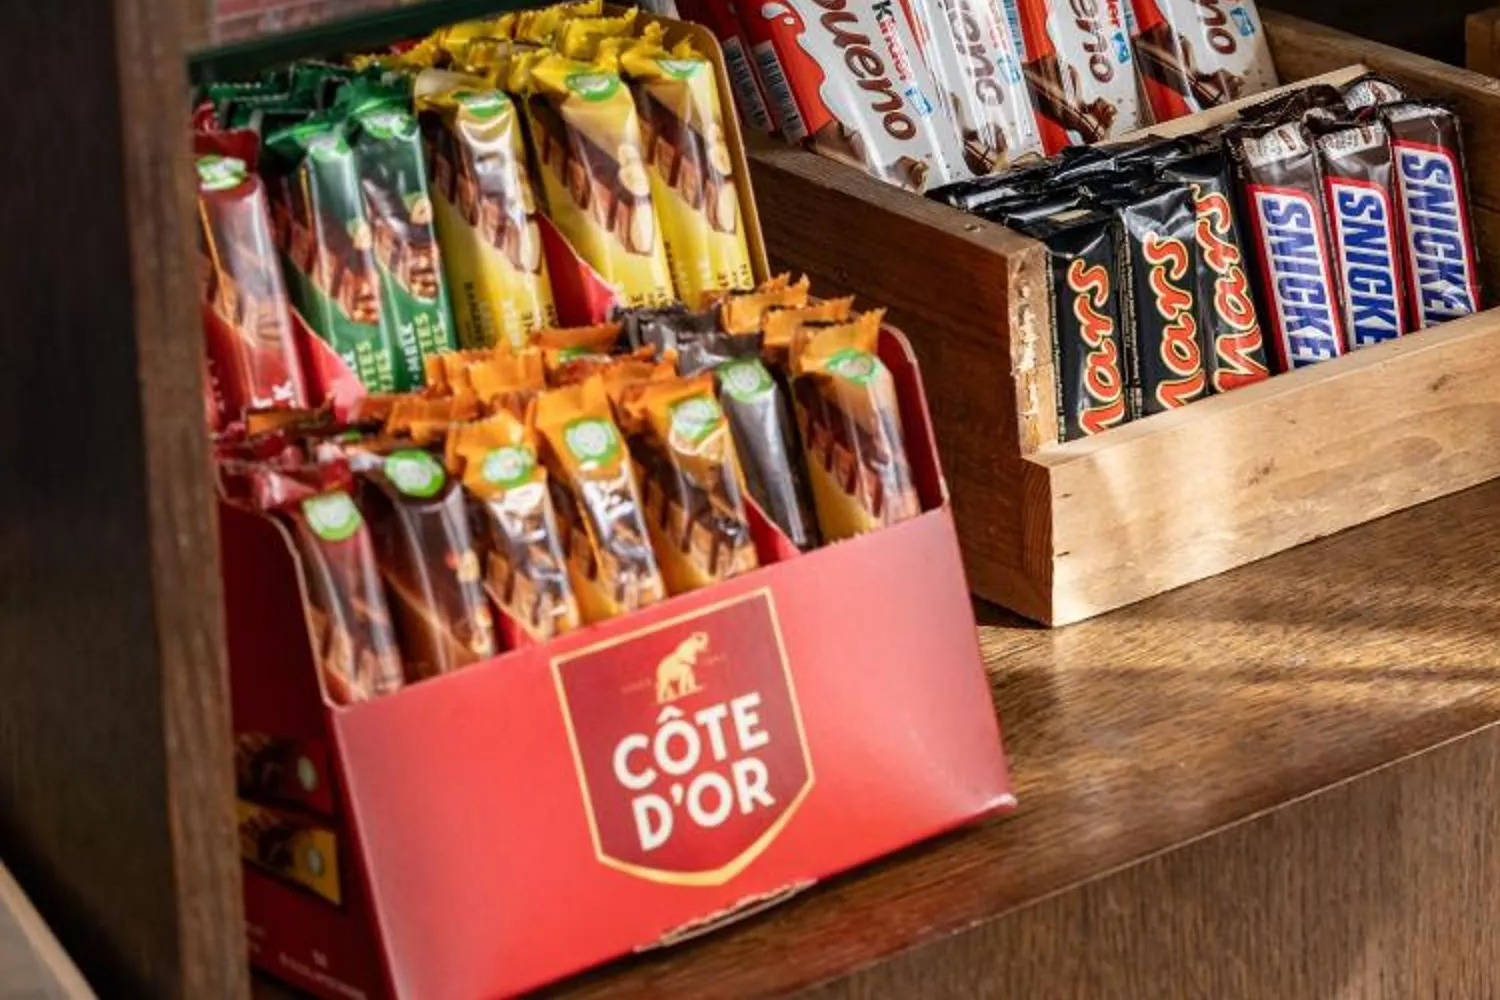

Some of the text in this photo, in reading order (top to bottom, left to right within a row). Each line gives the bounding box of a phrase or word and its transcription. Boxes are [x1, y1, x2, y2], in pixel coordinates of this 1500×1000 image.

[1261, 198, 1338, 369] SNICKE
[1337, 189, 1399, 346] SNICKE
[1401, 153, 1474, 327] SNICKE
[613, 692, 770, 790] CÔTE
[632, 757, 776, 851] D'OR
